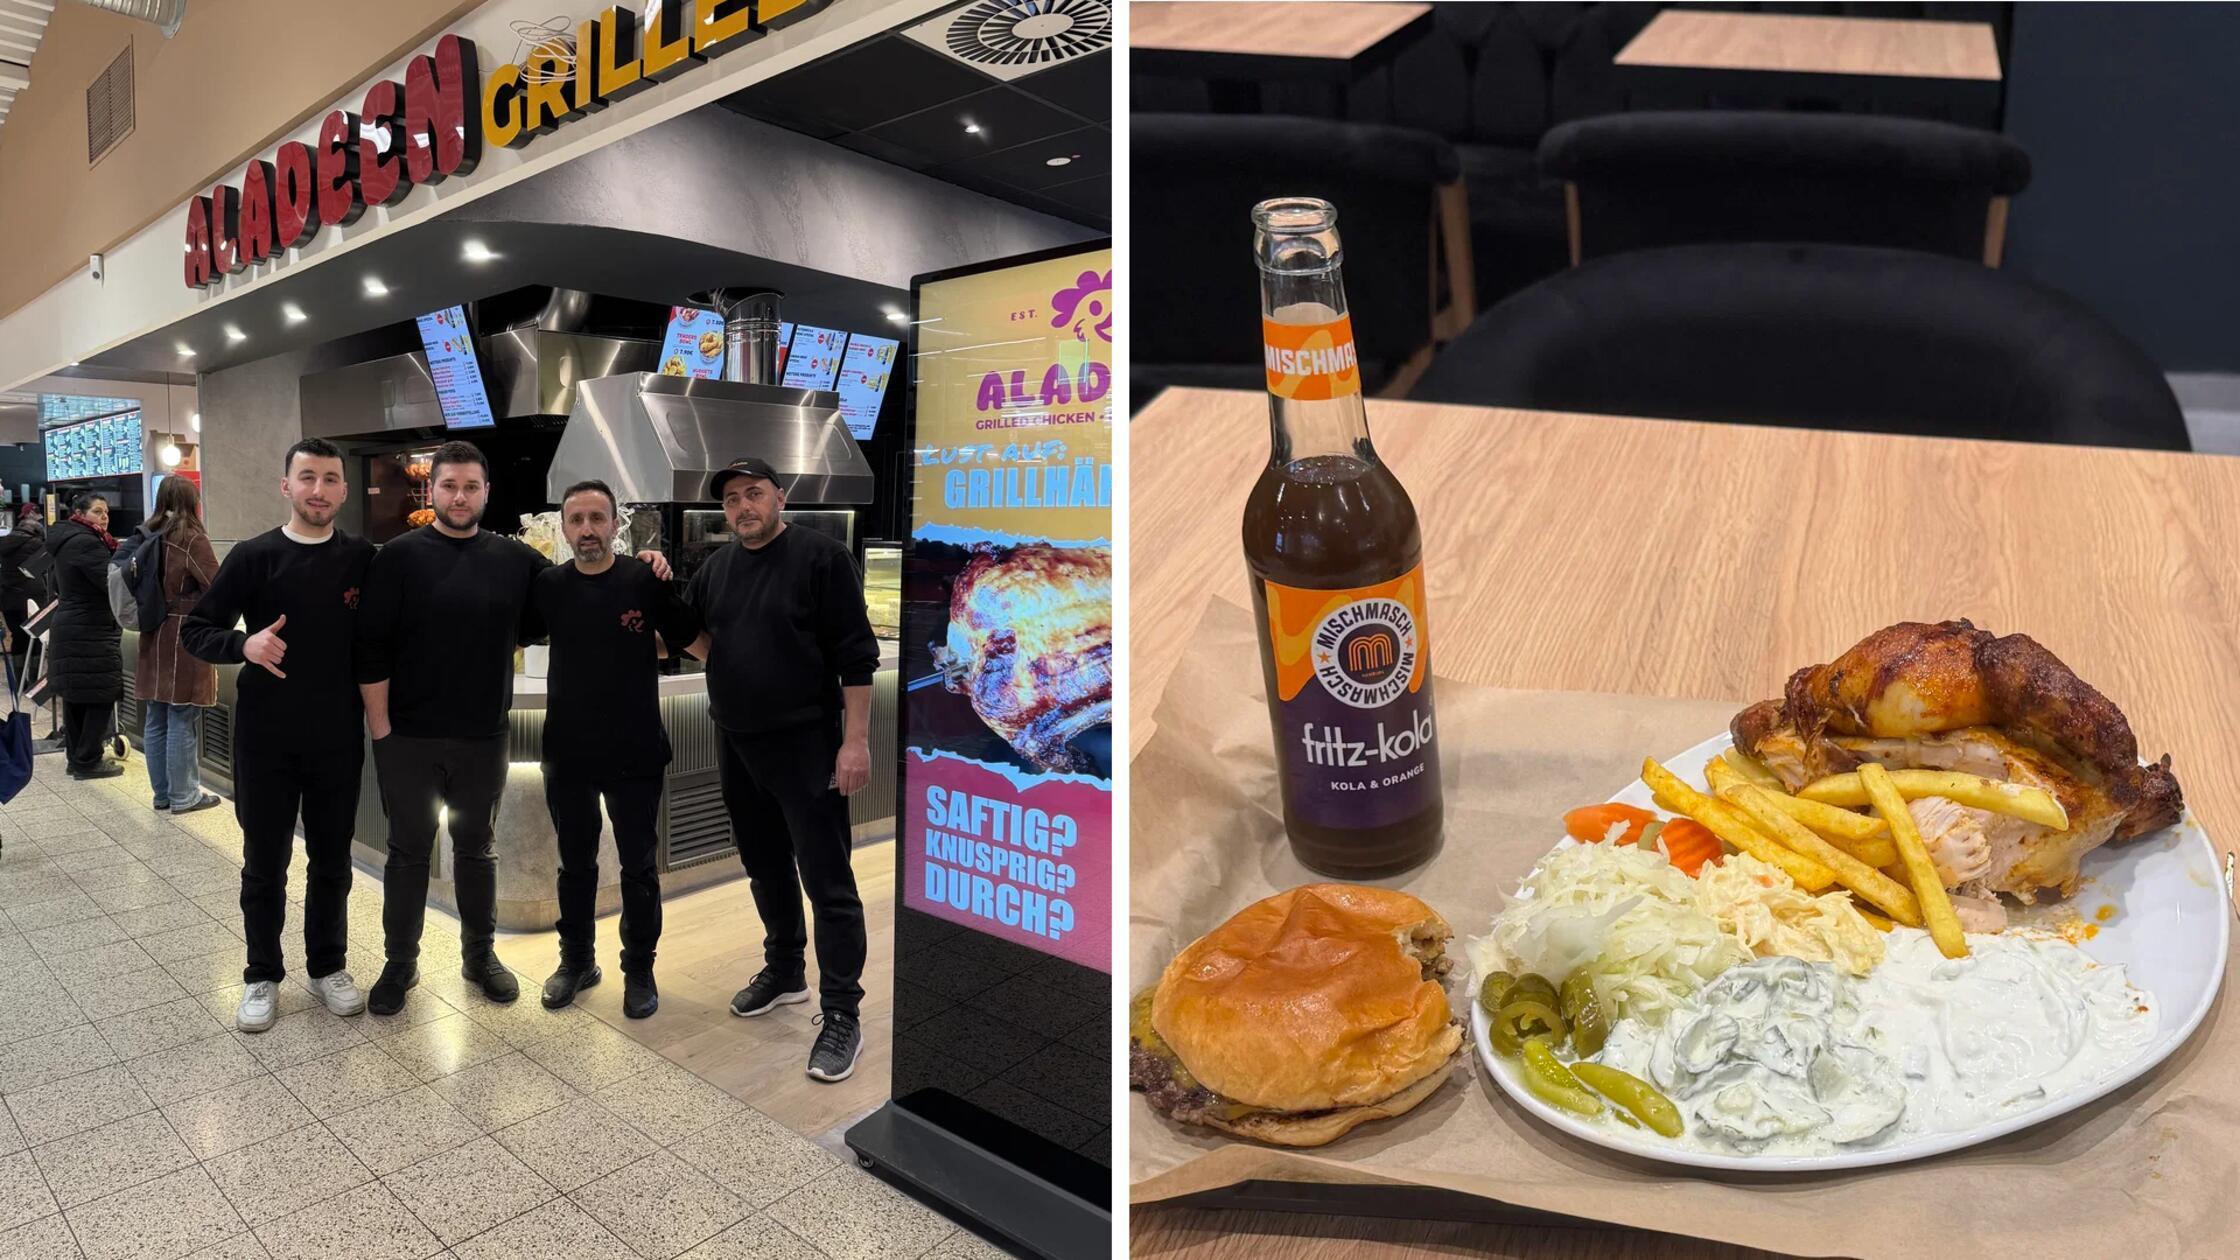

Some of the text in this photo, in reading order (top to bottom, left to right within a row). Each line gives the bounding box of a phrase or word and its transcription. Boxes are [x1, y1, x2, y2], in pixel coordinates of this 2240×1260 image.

[184, 34, 466, 289] ALADEEN
[1010, 308, 1038, 322] EST.
[976, 361, 1111, 412] ALAD
[975, 411, 1095, 430] GRILLED CHICKEN
[922, 439, 1068, 465] LUST AUF:
[1316, 602, 1413, 650] MISCHMASCH
[1318, 652, 1415, 705] MISCHMASCH
[1302, 709, 1434, 767] fritz-kola
[1330, 763, 1425, 791] KOLA & ORANGE
[925, 784, 1078, 857] SAFTIG?
[925, 828, 1076, 895] KNUSPRIG?
[924, 861, 1075, 941] DURCH?
